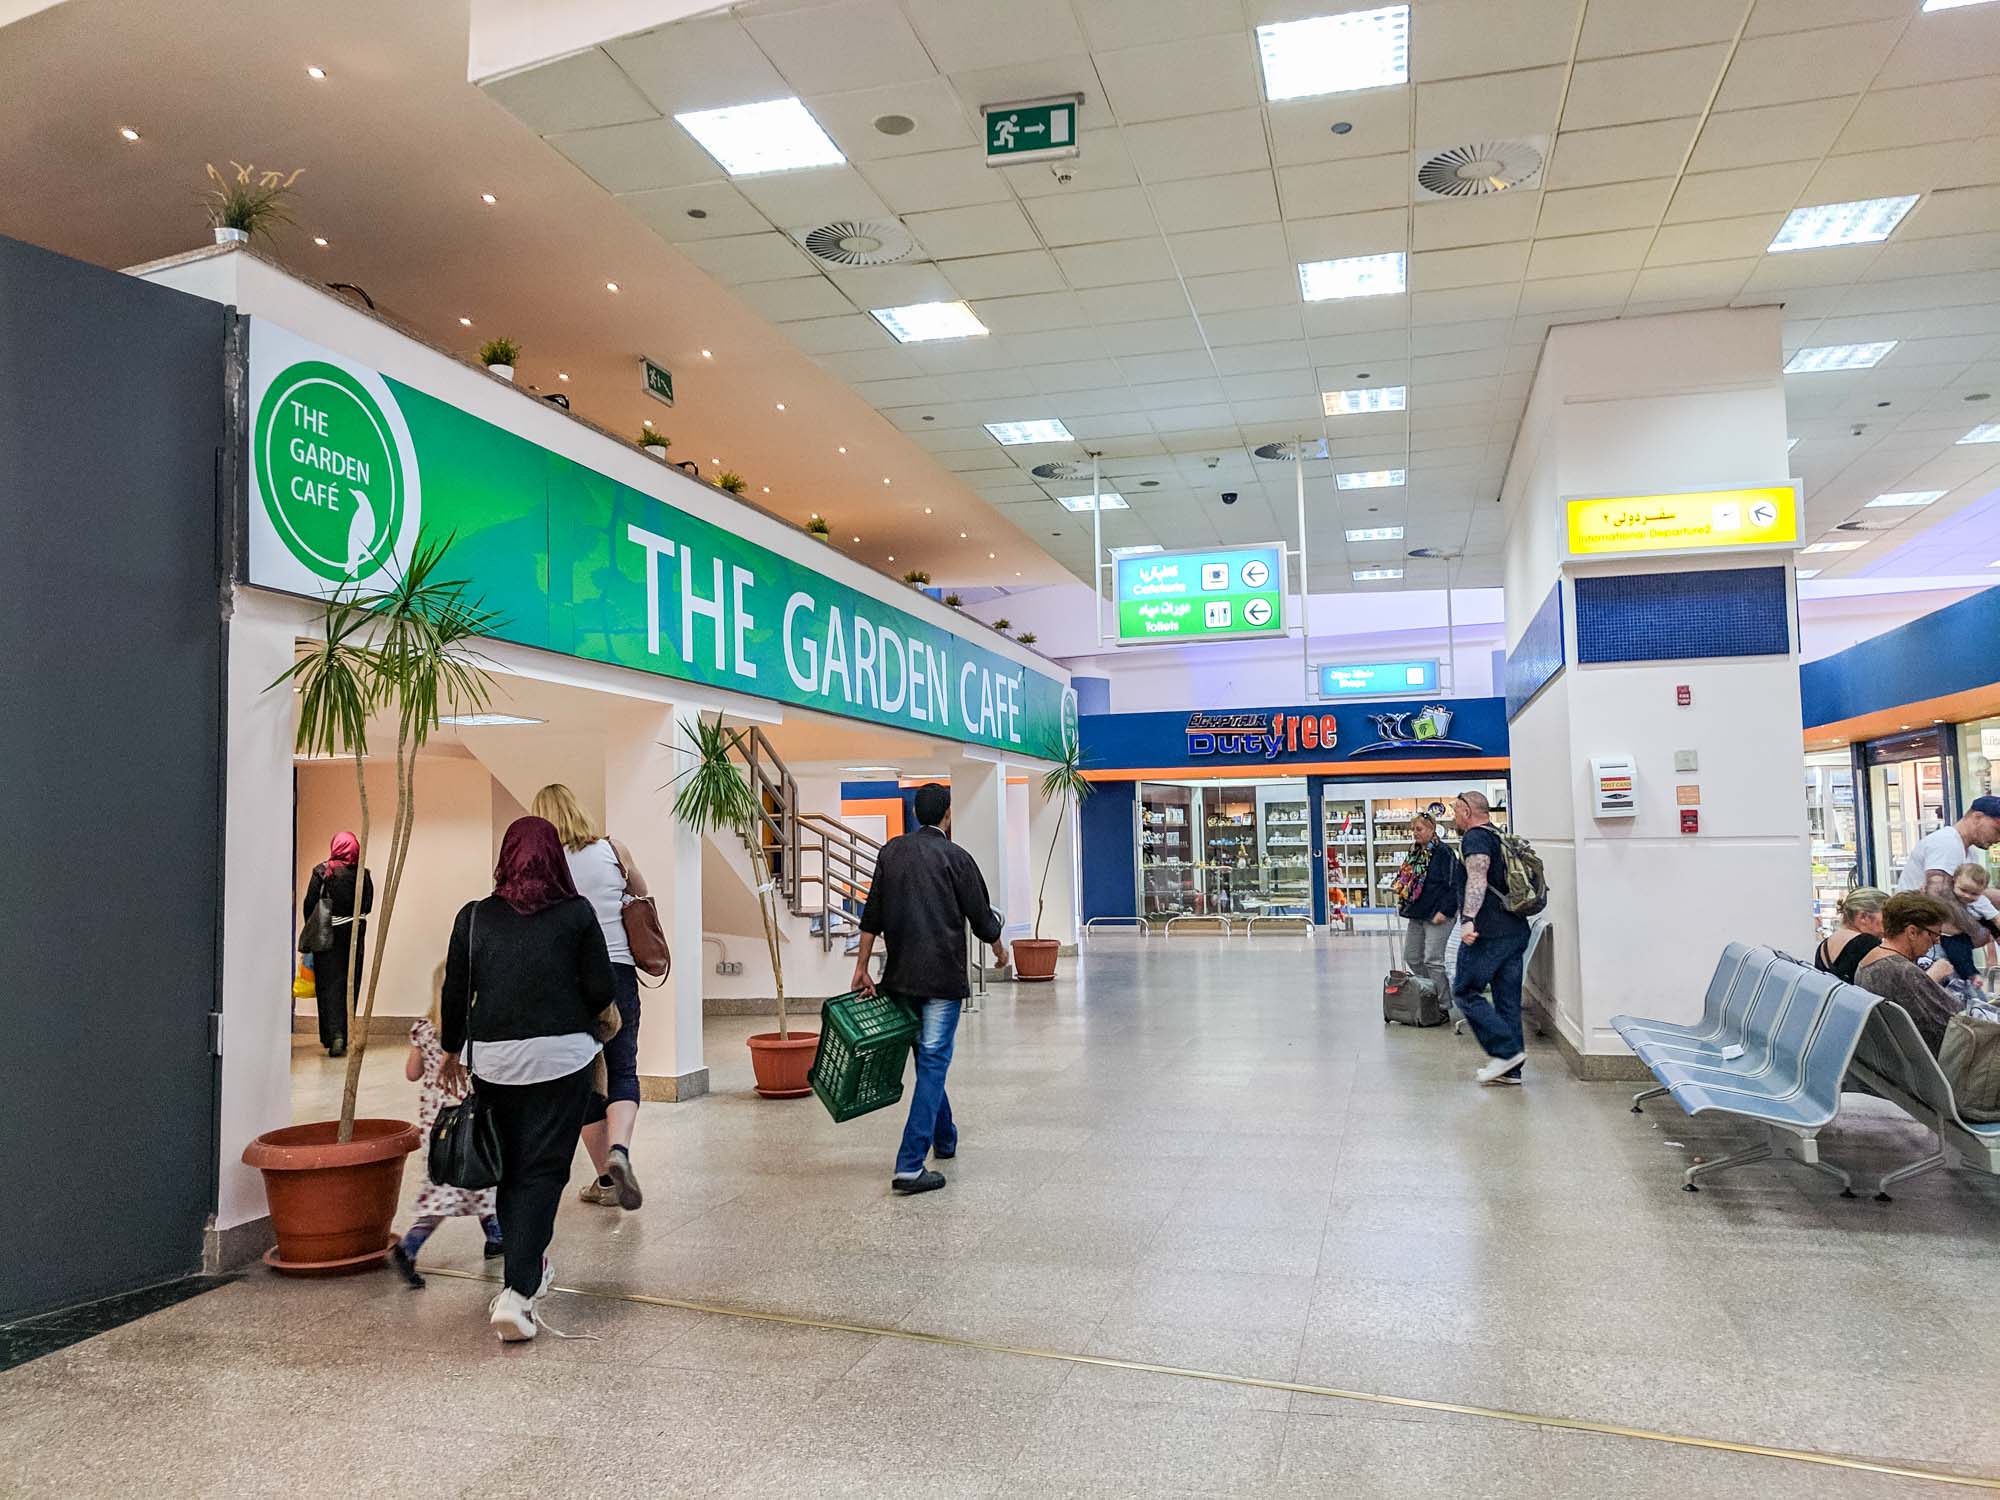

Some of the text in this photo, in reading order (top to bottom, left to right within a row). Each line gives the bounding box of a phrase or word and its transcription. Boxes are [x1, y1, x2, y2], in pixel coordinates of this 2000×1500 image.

[290, 400, 329, 437] THE
[289, 438, 370, 486] GARDEN
[290, 476, 340, 511] CAFÉ
[1578, 530, 1645, 544] International
[627, 523, 757, 679] THE
[782, 591, 949, 726] GARDEN
[1145, 621, 1179, 632] Toilets
[1187, 712, 1338, 759] Duty free
